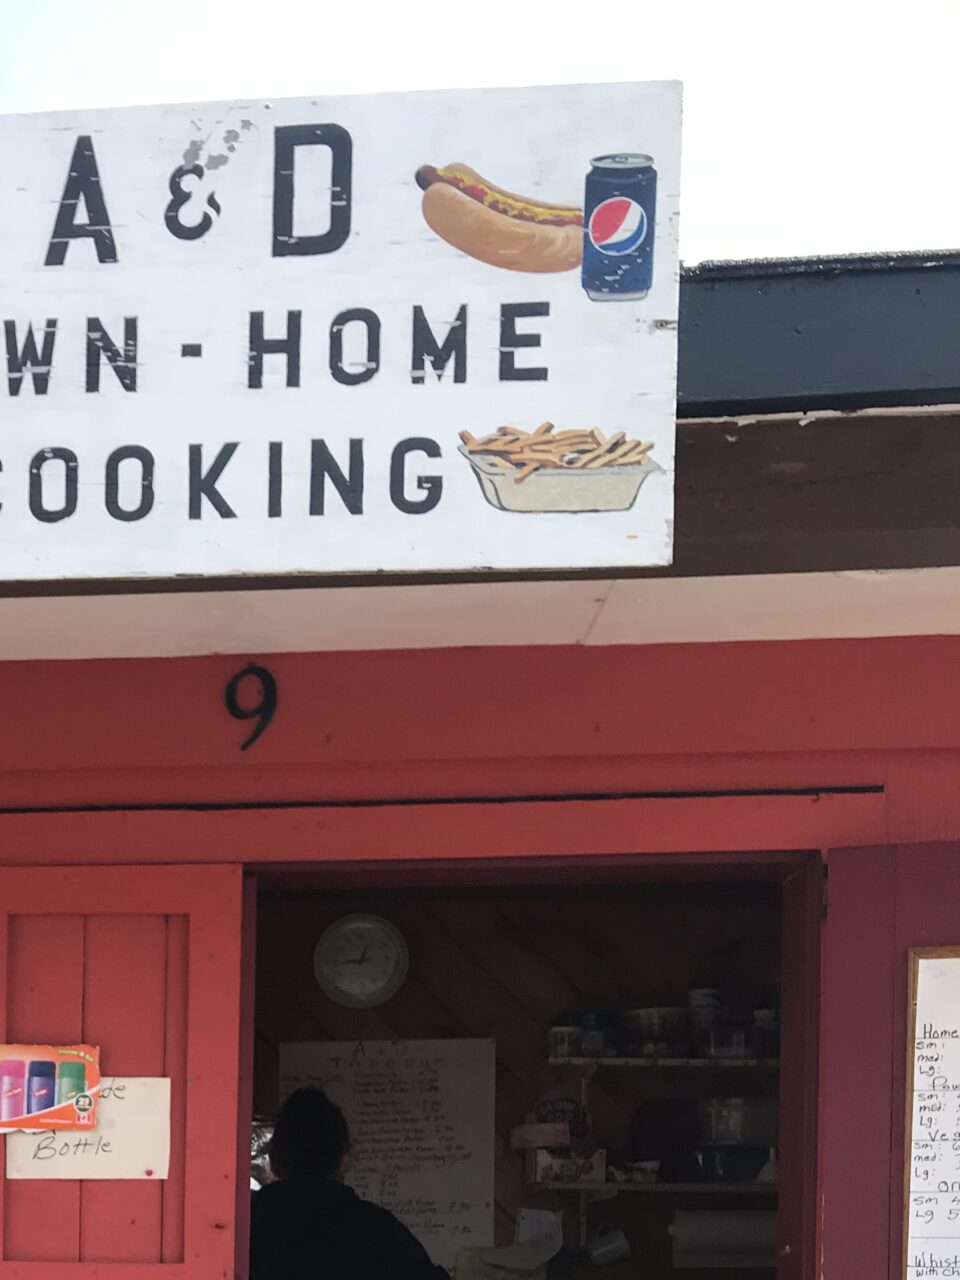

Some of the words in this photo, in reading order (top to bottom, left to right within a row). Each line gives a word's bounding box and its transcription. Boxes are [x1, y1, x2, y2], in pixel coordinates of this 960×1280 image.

[44, 135, 118, 267] A
[164, 162, 222, 243] &
[271, 122, 353, 257] D
[225, 663, 277, 751] 9
[923, 1023, 959, 1039] Home
[32, 1136, 113, 1160] Bottle
